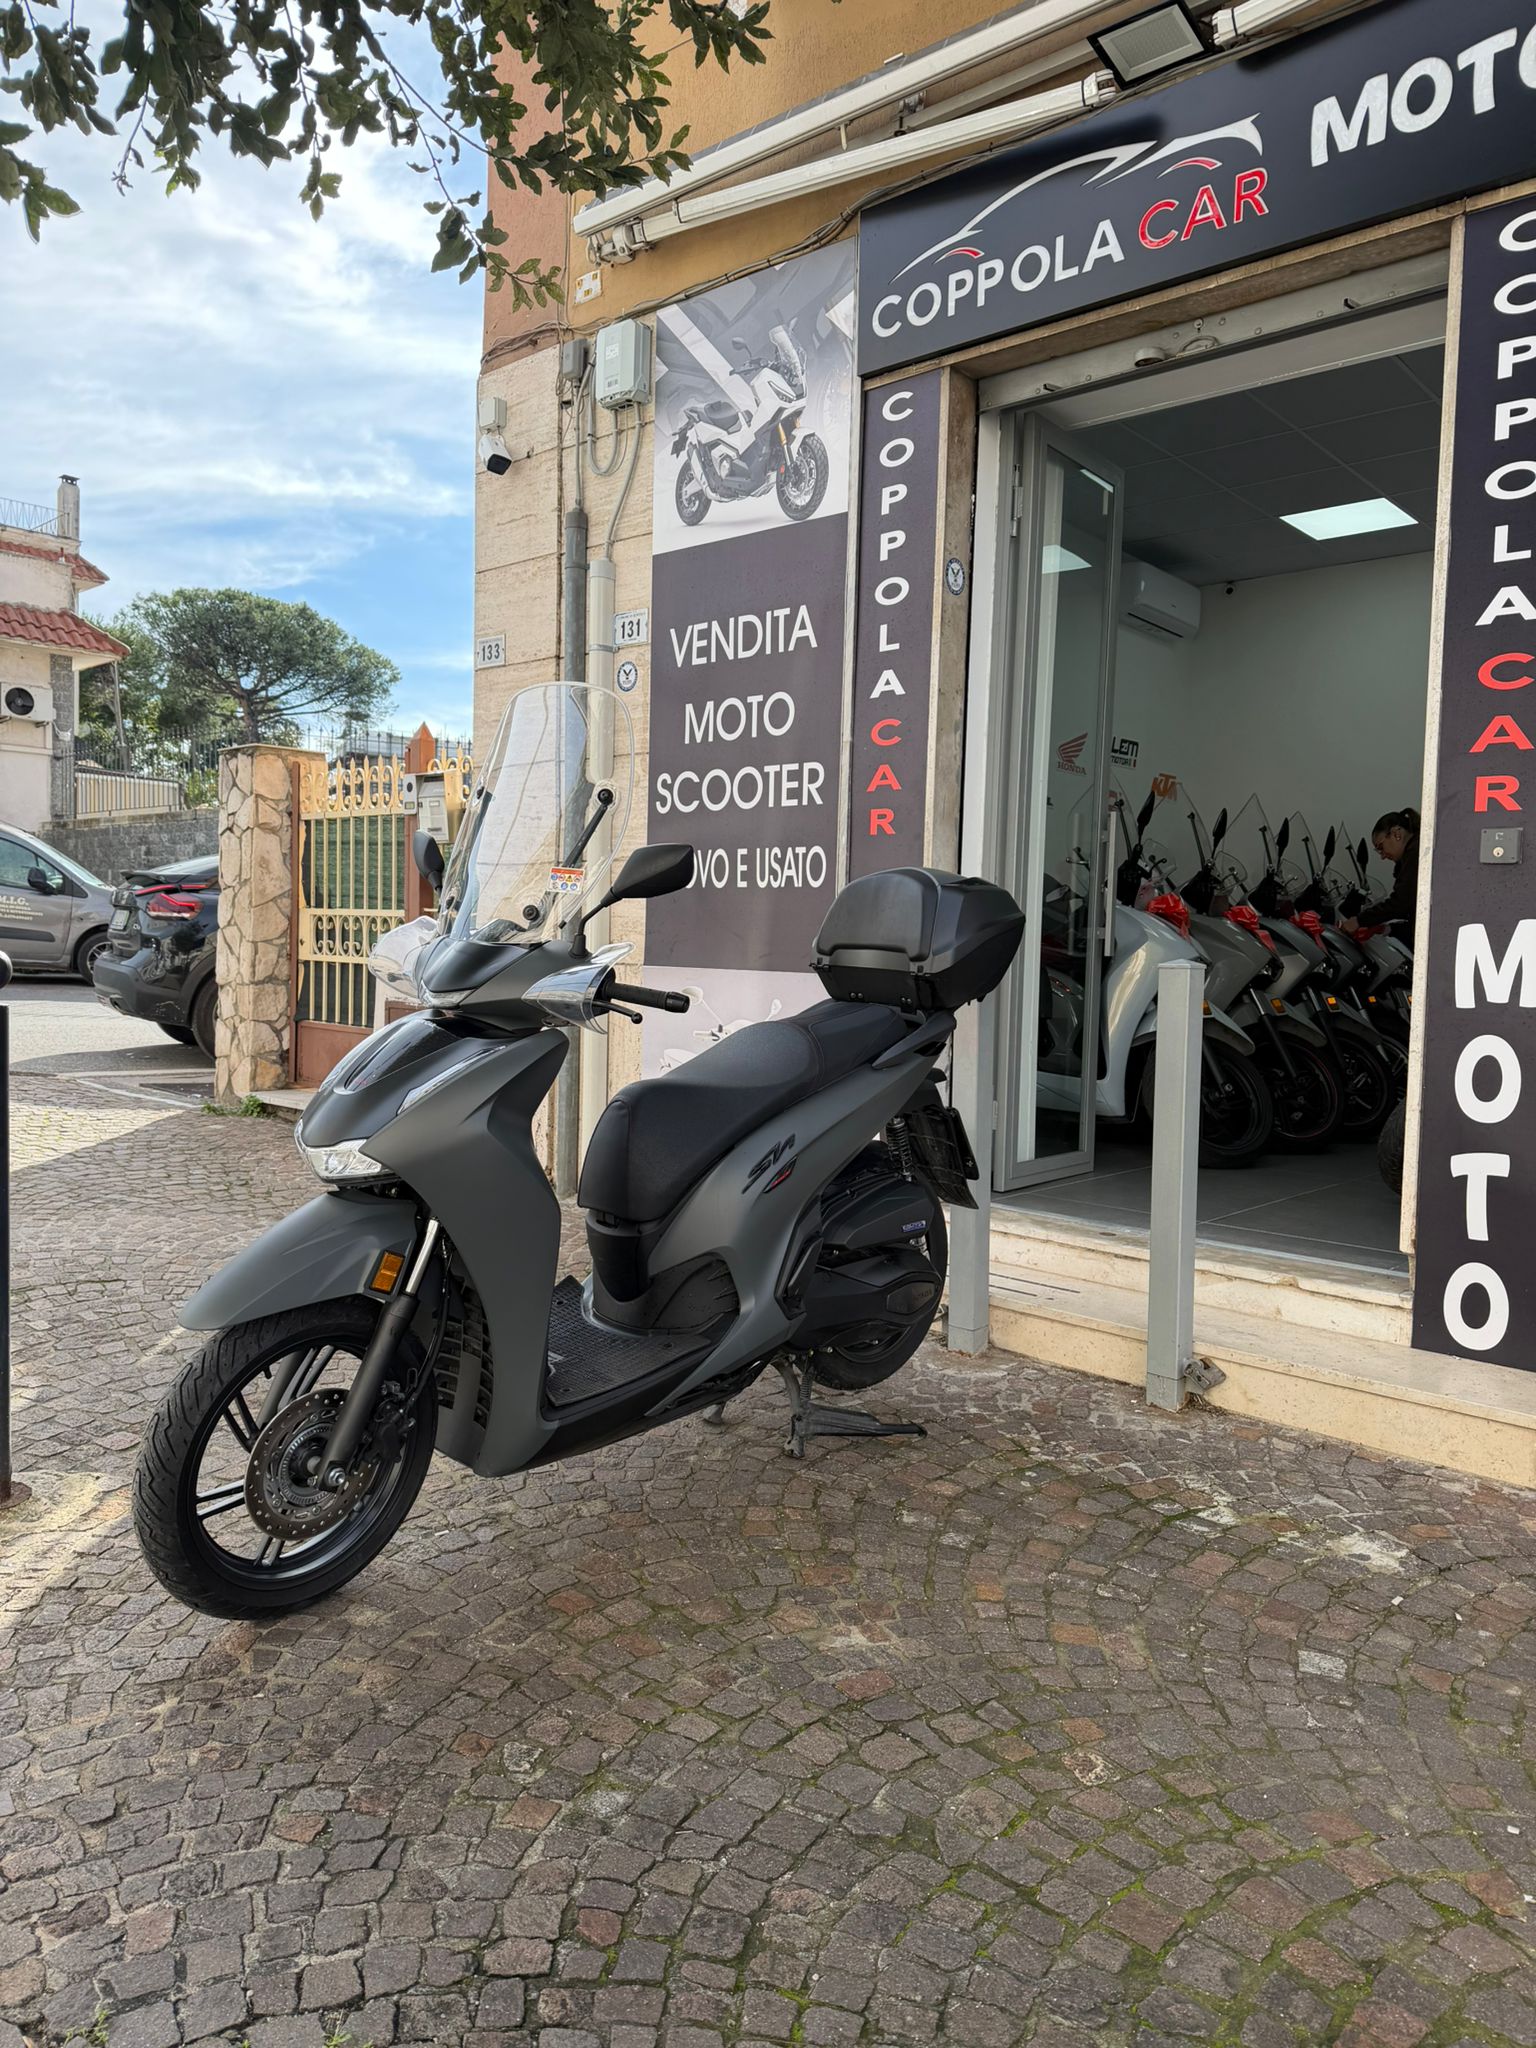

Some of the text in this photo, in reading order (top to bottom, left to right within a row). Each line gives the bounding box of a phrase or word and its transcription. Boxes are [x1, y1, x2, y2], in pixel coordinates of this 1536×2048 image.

[872, 167, 1270, 338] COPPOLA CAR
[621, 618, 641, 639] 131
[670, 604, 818, 668] VENDITA
[866, 391, 914, 836] COPPOLA CAR
[482, 643, 500, 662] 133
[684, 691, 796, 745] MOTO
[1468, 652, 1535, 813] CAR
[655, 762, 825, 814] SCOOTER
[1057, 761, 1087, 776] HONDA
[736, 847, 748, 888] E
[756, 845, 827, 888] USATO
[1443, 918, 1536, 1350] MOTO
